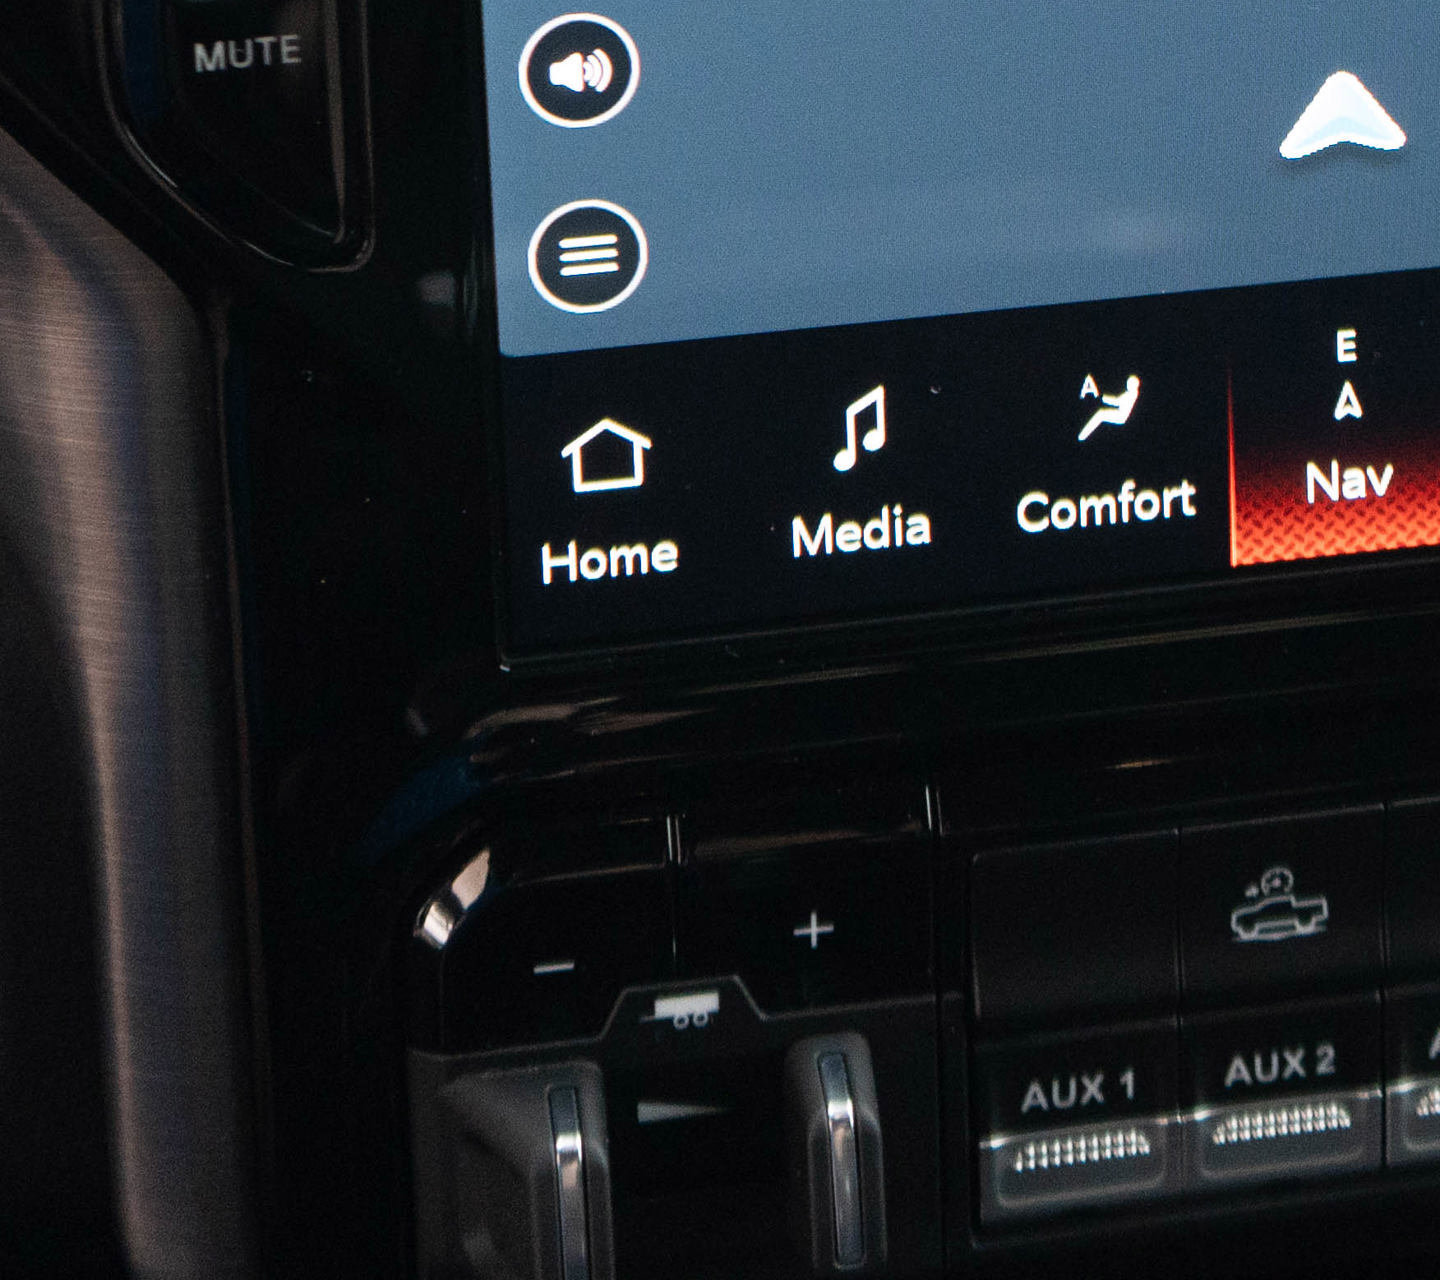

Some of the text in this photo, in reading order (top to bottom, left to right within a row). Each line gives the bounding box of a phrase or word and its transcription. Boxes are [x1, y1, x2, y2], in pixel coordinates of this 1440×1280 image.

[194, 35, 302, 73] MUTE
[1335, 329, 1358, 364] E
[1305, 461, 1395, 506] Nav
[1016, 479, 1198, 534] Comfort
[790, 503, 933, 559] Media
[541, 538, 679, 586] Home
[1224, 1046, 1336, 1088] AUX 2
[1021, 1069, 1137, 1114] AUX 1
